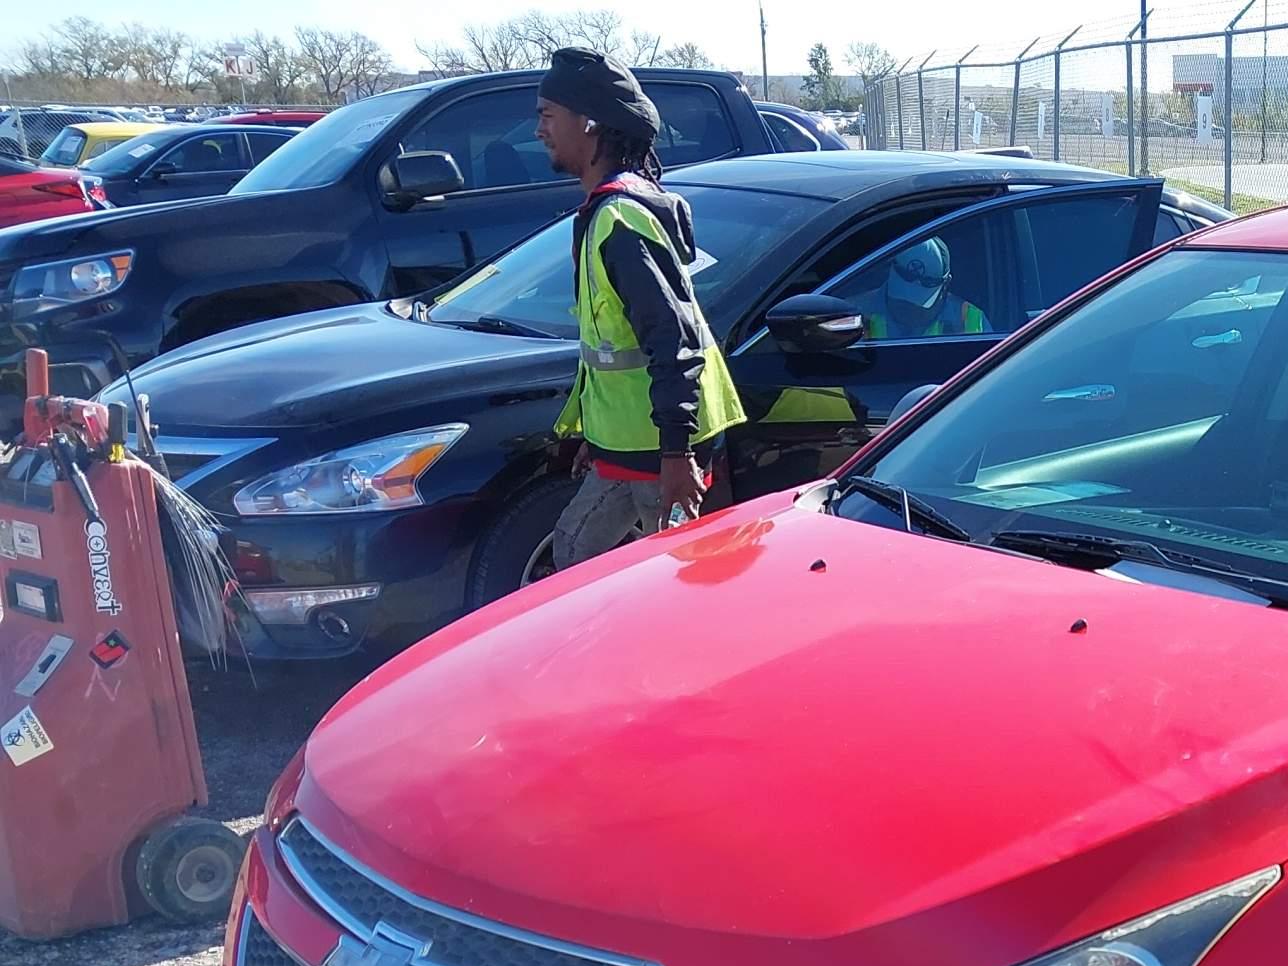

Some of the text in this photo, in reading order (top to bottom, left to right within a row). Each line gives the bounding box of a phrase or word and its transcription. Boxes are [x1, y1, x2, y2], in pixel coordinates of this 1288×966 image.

[224, 59, 236, 74] K
[246, 60, 253, 75] J
[1202, 112, 1207, 129] 9
